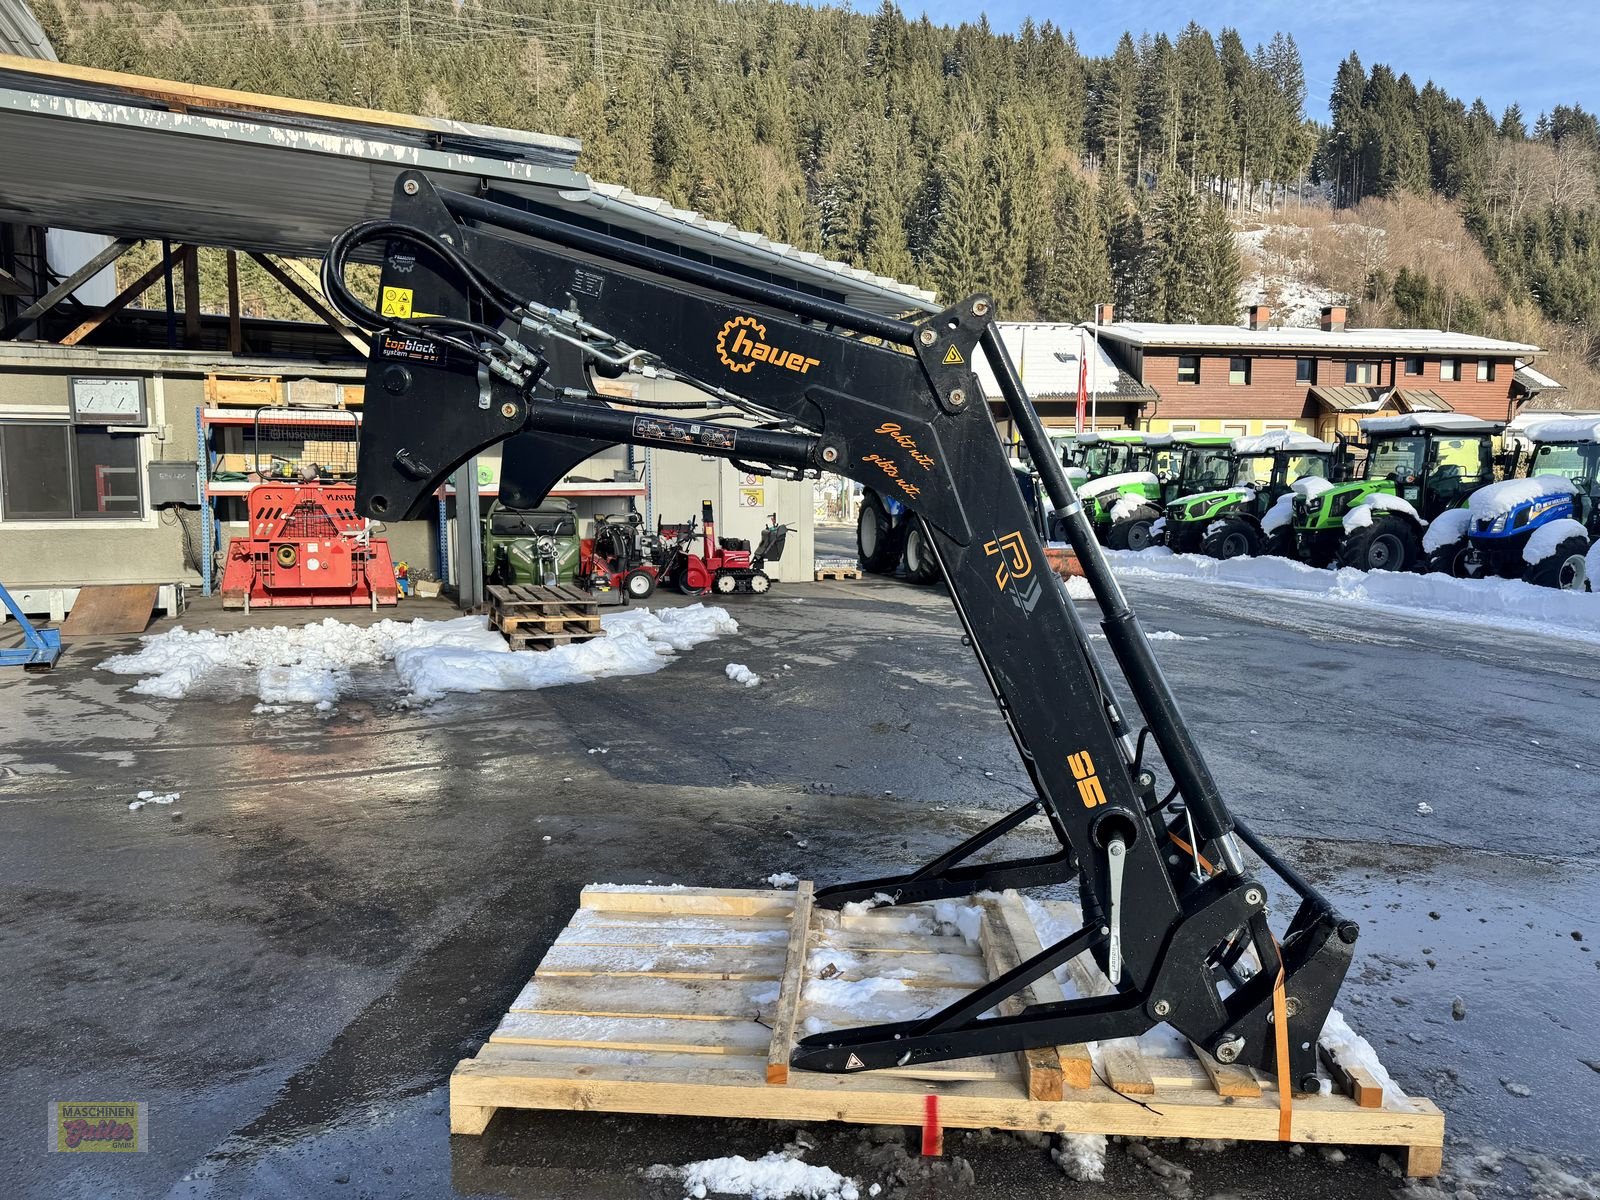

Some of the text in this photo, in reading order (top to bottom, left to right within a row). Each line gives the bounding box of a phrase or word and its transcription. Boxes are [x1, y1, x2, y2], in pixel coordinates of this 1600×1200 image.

[383, 349, 408, 357] system
[384, 337, 436, 354] topblock
[731, 328, 820, 374] hauer
[874, 422, 917, 448] Geht
[861, 454, 899, 478] gibts
